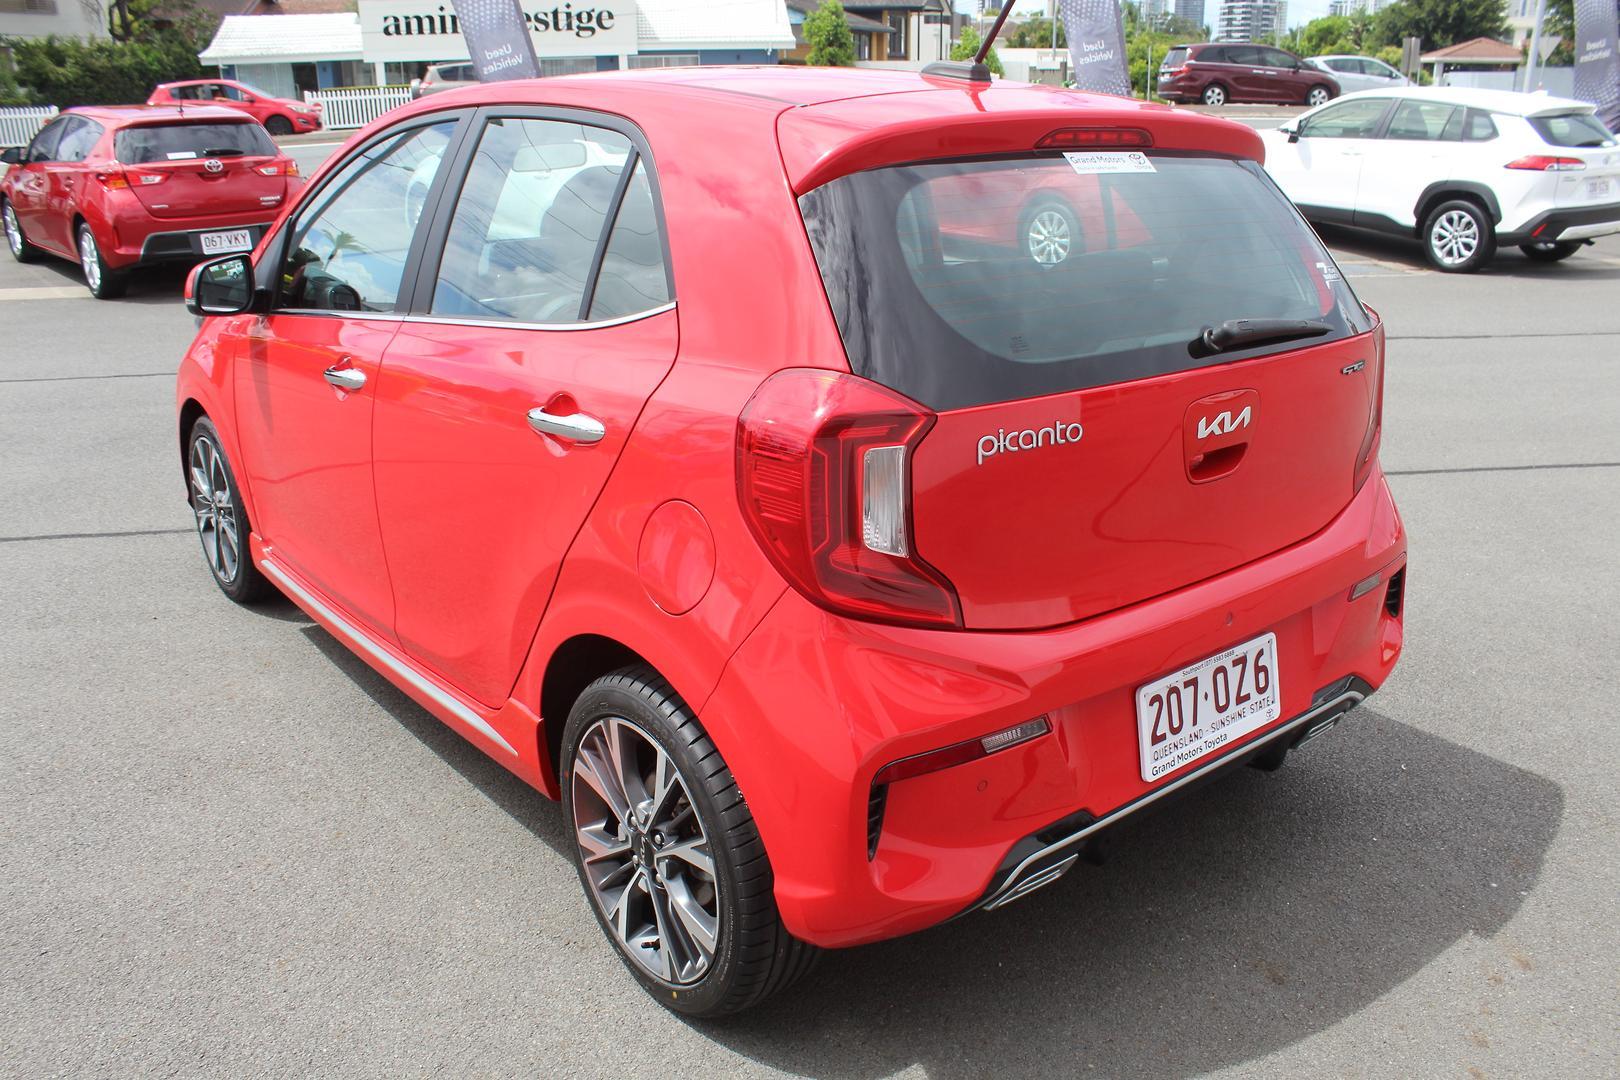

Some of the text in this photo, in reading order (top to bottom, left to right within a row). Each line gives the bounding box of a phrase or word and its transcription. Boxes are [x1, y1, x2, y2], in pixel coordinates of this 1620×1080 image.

[977, 420, 1083, 466] picanto
[1152, 732, 1228, 777] Grand Motors Toyota
[1153, 728, 1204, 761] QUEENSLAND
[1210, 707, 1246, 733] SUNSHINE
